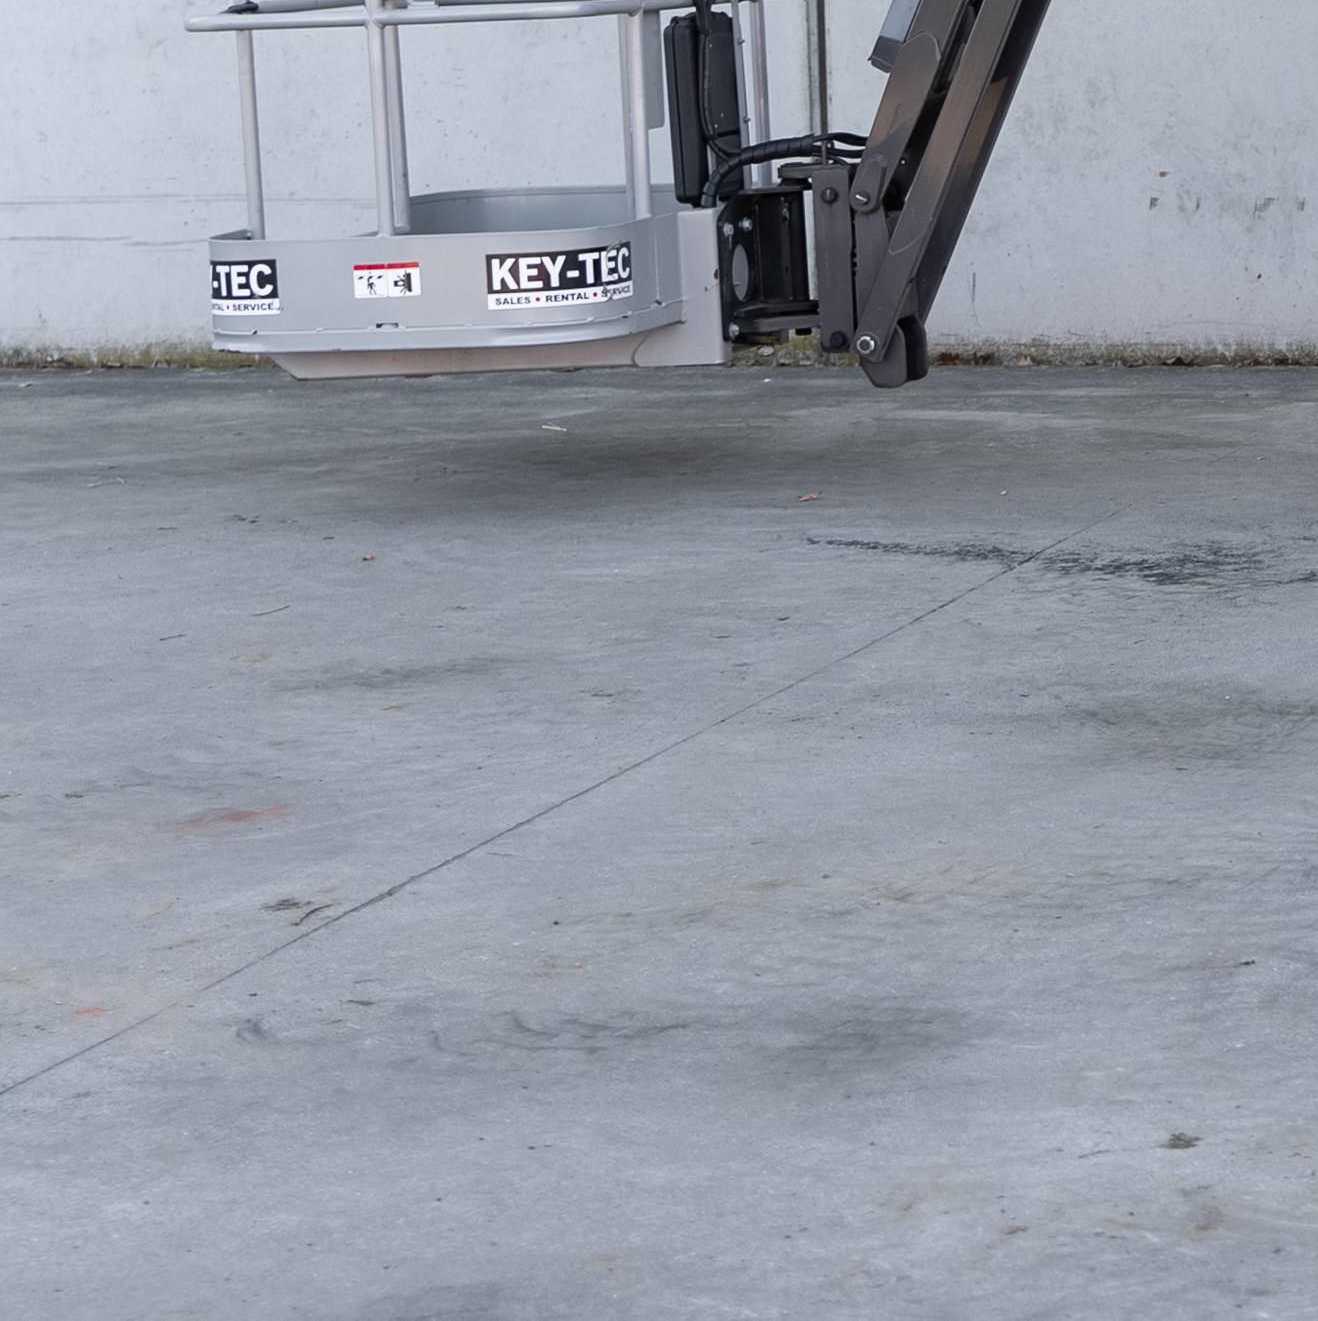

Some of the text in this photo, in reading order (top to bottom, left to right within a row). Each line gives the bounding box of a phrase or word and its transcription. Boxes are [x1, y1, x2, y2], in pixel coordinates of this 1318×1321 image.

[210, 263, 274, 297] -TEC
[491, 247, 631, 291] KEY-TEC
[232, 302, 274, 312] SERVICE
[495, 296, 531, 306] SALES
[545, 292, 590, 303] RENTAL
